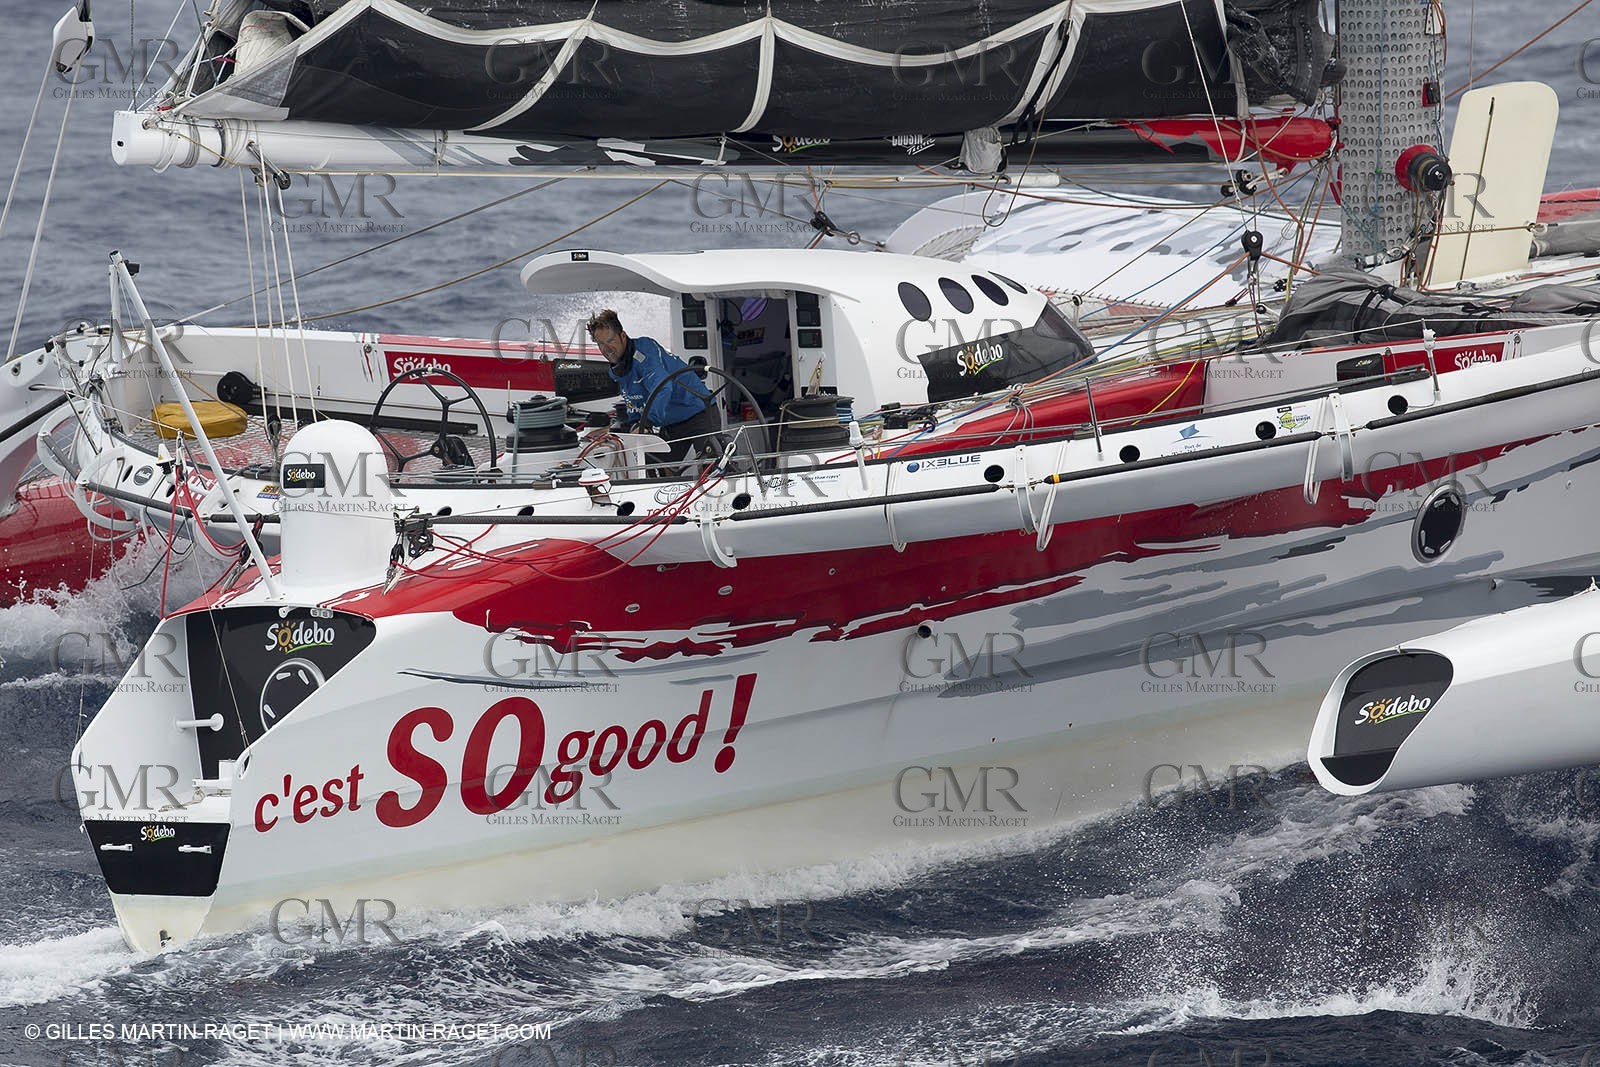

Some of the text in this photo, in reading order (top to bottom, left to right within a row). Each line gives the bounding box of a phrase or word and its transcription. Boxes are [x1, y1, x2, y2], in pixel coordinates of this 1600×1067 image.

[957, 341, 1004, 377] Sodebo
[287, 468, 316, 481] Sodebo
[265, 620, 335, 652] Sodebo
[1355, 695, 1431, 725] Sodebo
[253, 763, 364, 833] c'est
[375, 696, 545, 828] SO
[141, 824, 175, 841] Sodebo
